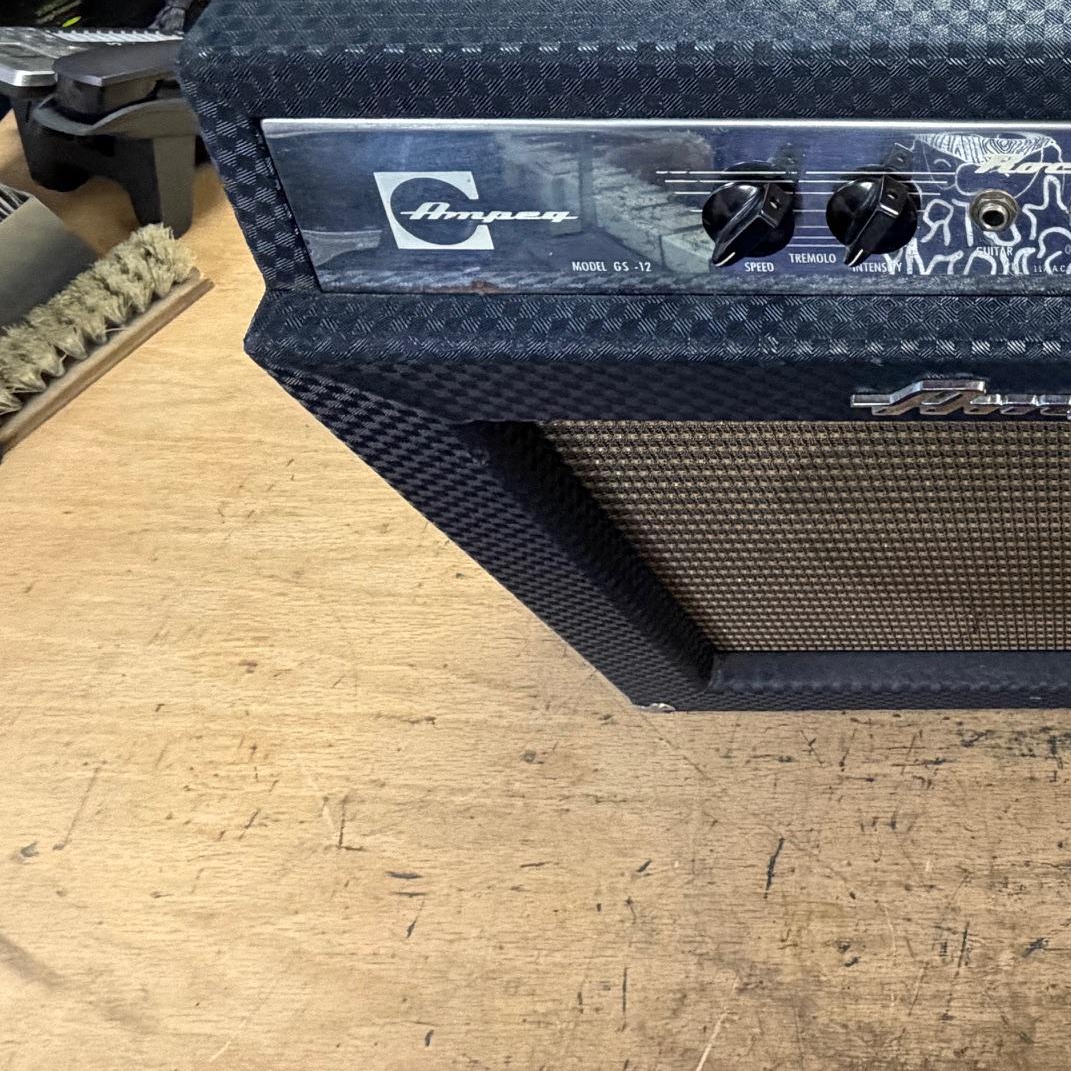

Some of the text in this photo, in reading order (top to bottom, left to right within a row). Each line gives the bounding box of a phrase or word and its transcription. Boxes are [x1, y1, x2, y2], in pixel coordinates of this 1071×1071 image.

[400, 201, 579, 223] Ampeg
[976, 246, 1013, 256] GUITAR
[788, 252, 837, 264] TREMOLO
[571, 261, 607, 272] MODEL
[613, 261, 630, 272] GS
[744, 261, 774, 272] SPEED
